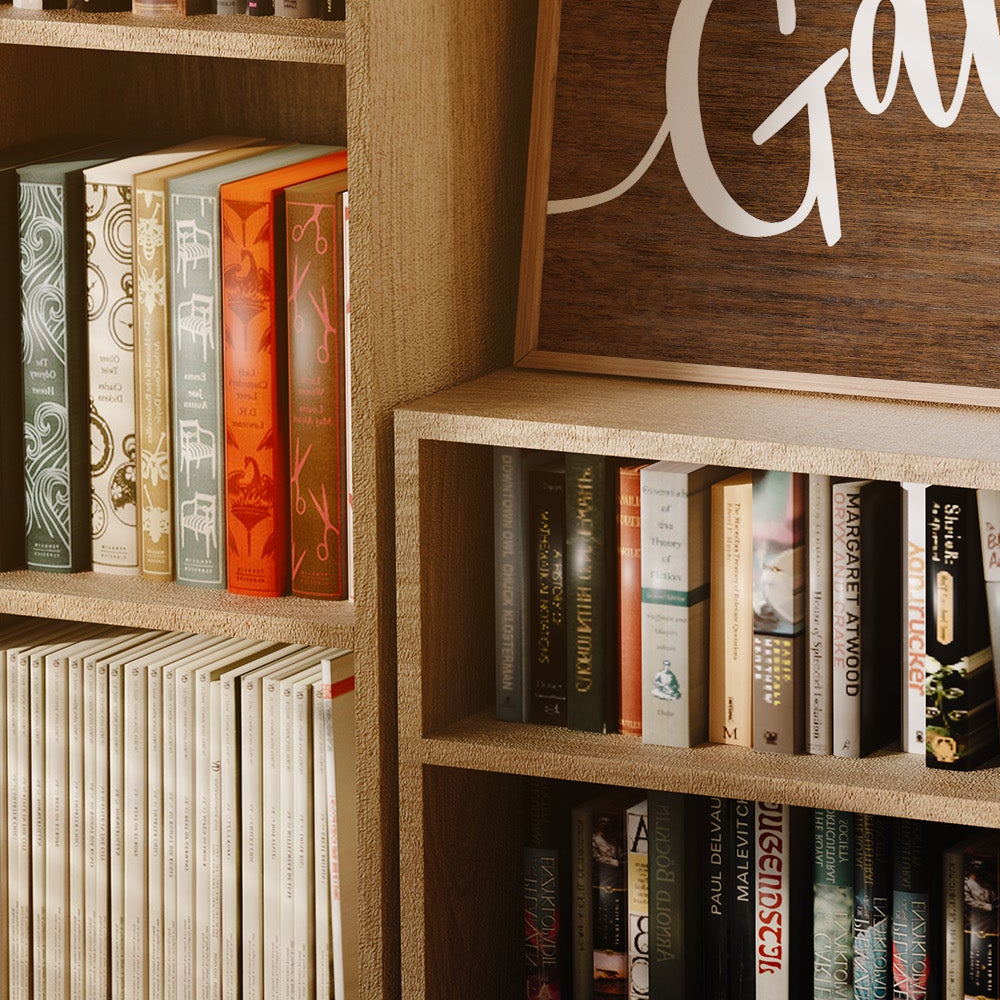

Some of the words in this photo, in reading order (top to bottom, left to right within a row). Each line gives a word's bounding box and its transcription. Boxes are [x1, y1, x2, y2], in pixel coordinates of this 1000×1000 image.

[502, 455, 514, 528] DOWNTOWN
[834, 491, 846, 545] ORYX
[502, 531, 514, 556] OWL
[834, 550, 846, 591] AND
[846, 493, 861, 605] MARGARET
[502, 610, 514, 690] KLOSTERMAN
[834, 602, 846, 669] CRAKE
[845, 612, 860, 697] ATWOOD
[711, 798, 722, 867] DELVAU
[711, 871, 722, 915] PAUL
